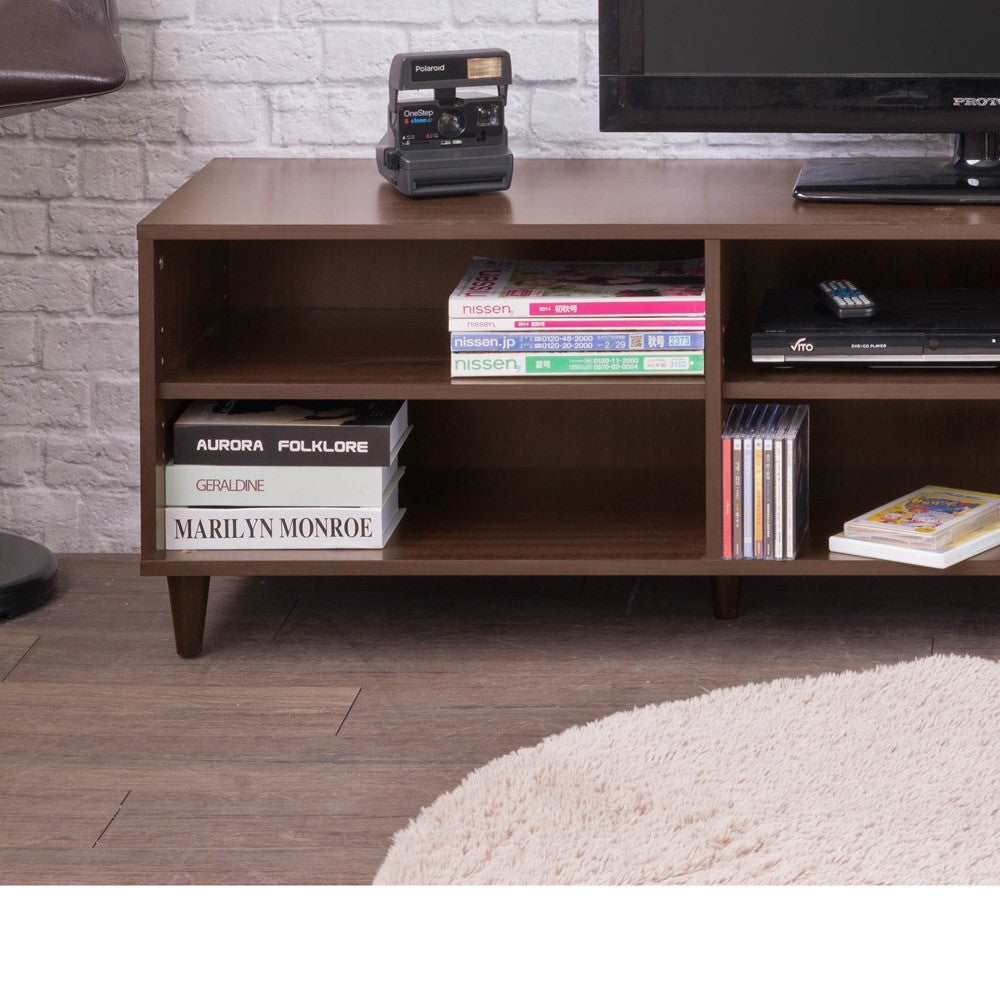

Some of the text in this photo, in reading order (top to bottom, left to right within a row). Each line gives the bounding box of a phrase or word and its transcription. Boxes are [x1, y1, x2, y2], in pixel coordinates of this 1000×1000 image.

[415, 64, 445, 73] Polaroid
[403, 109, 434, 118] OneStep
[454, 336, 516, 349] nissen.jp
[196, 438, 369, 454] AURORA FOLKLORE
[196, 478, 265, 492] GERALDINE
[174, 517, 373, 540] MARILYN MONROE
